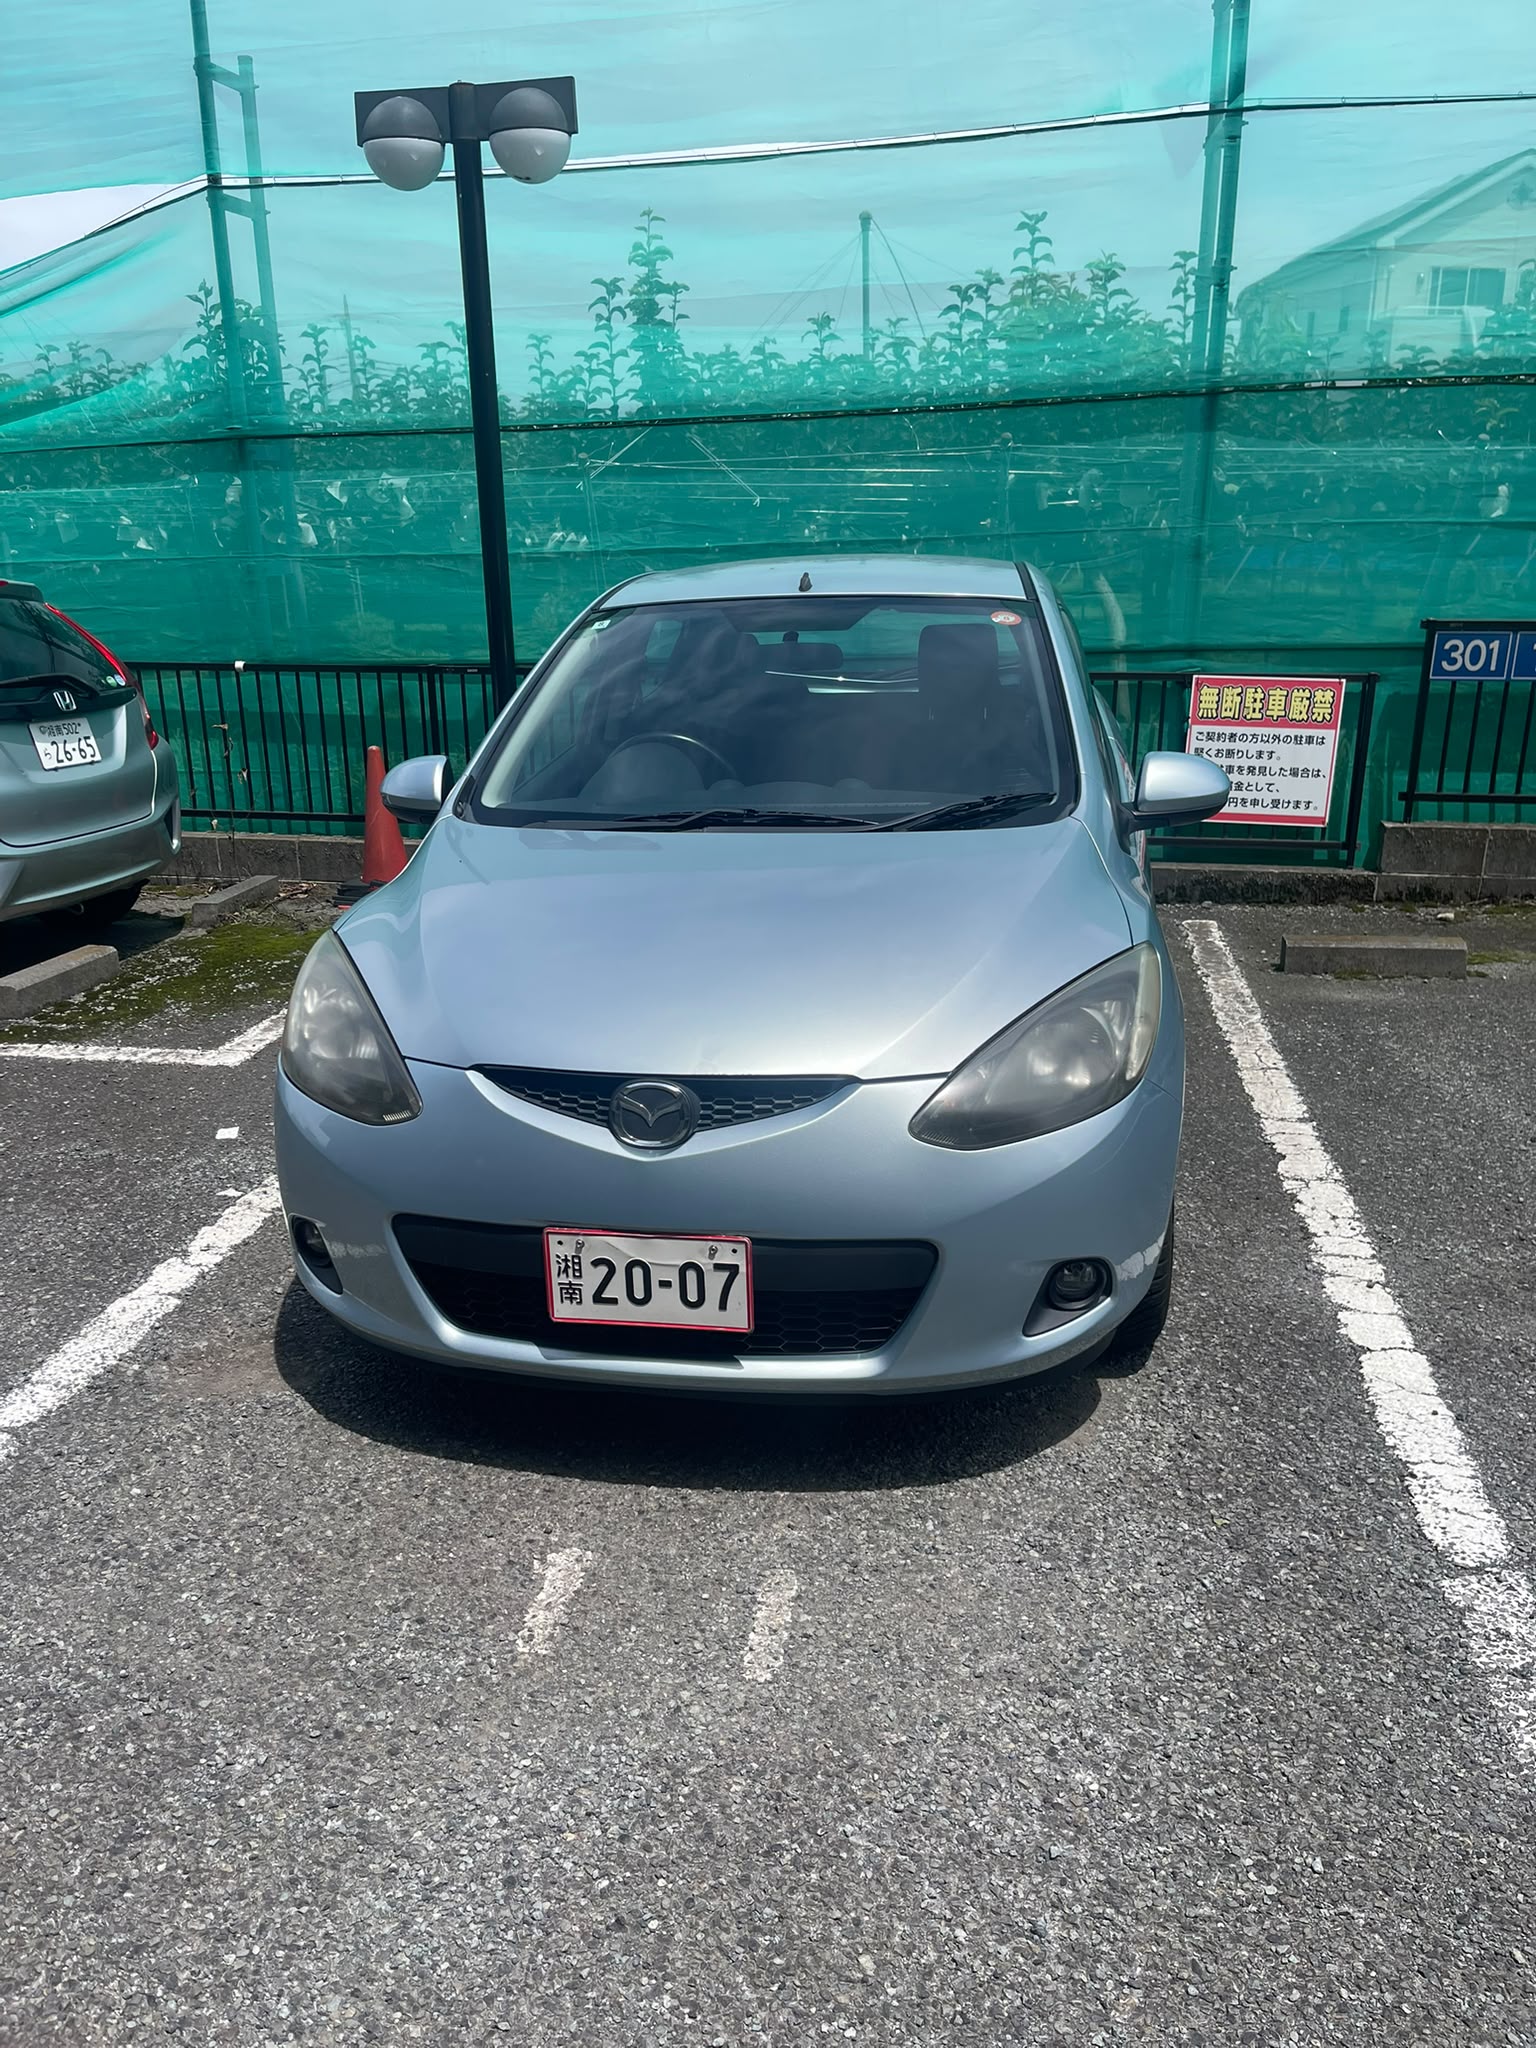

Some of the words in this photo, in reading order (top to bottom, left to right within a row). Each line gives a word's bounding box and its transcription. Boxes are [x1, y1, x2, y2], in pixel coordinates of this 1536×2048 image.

[1441, 638, 1500, 672] 301
[1197, 685, 1335, 723] 無断駐車厳禁
[1195, 731, 1326, 746] ご契約者の方以外の駐車は
[1219, 764, 1327, 779] 車を発見した場合は、
[1227, 797, 1318, 811] 円を申し受けます。
[555, 1253, 583, 1305] 湘南
[590, 1257, 740, 1312] 20-07
